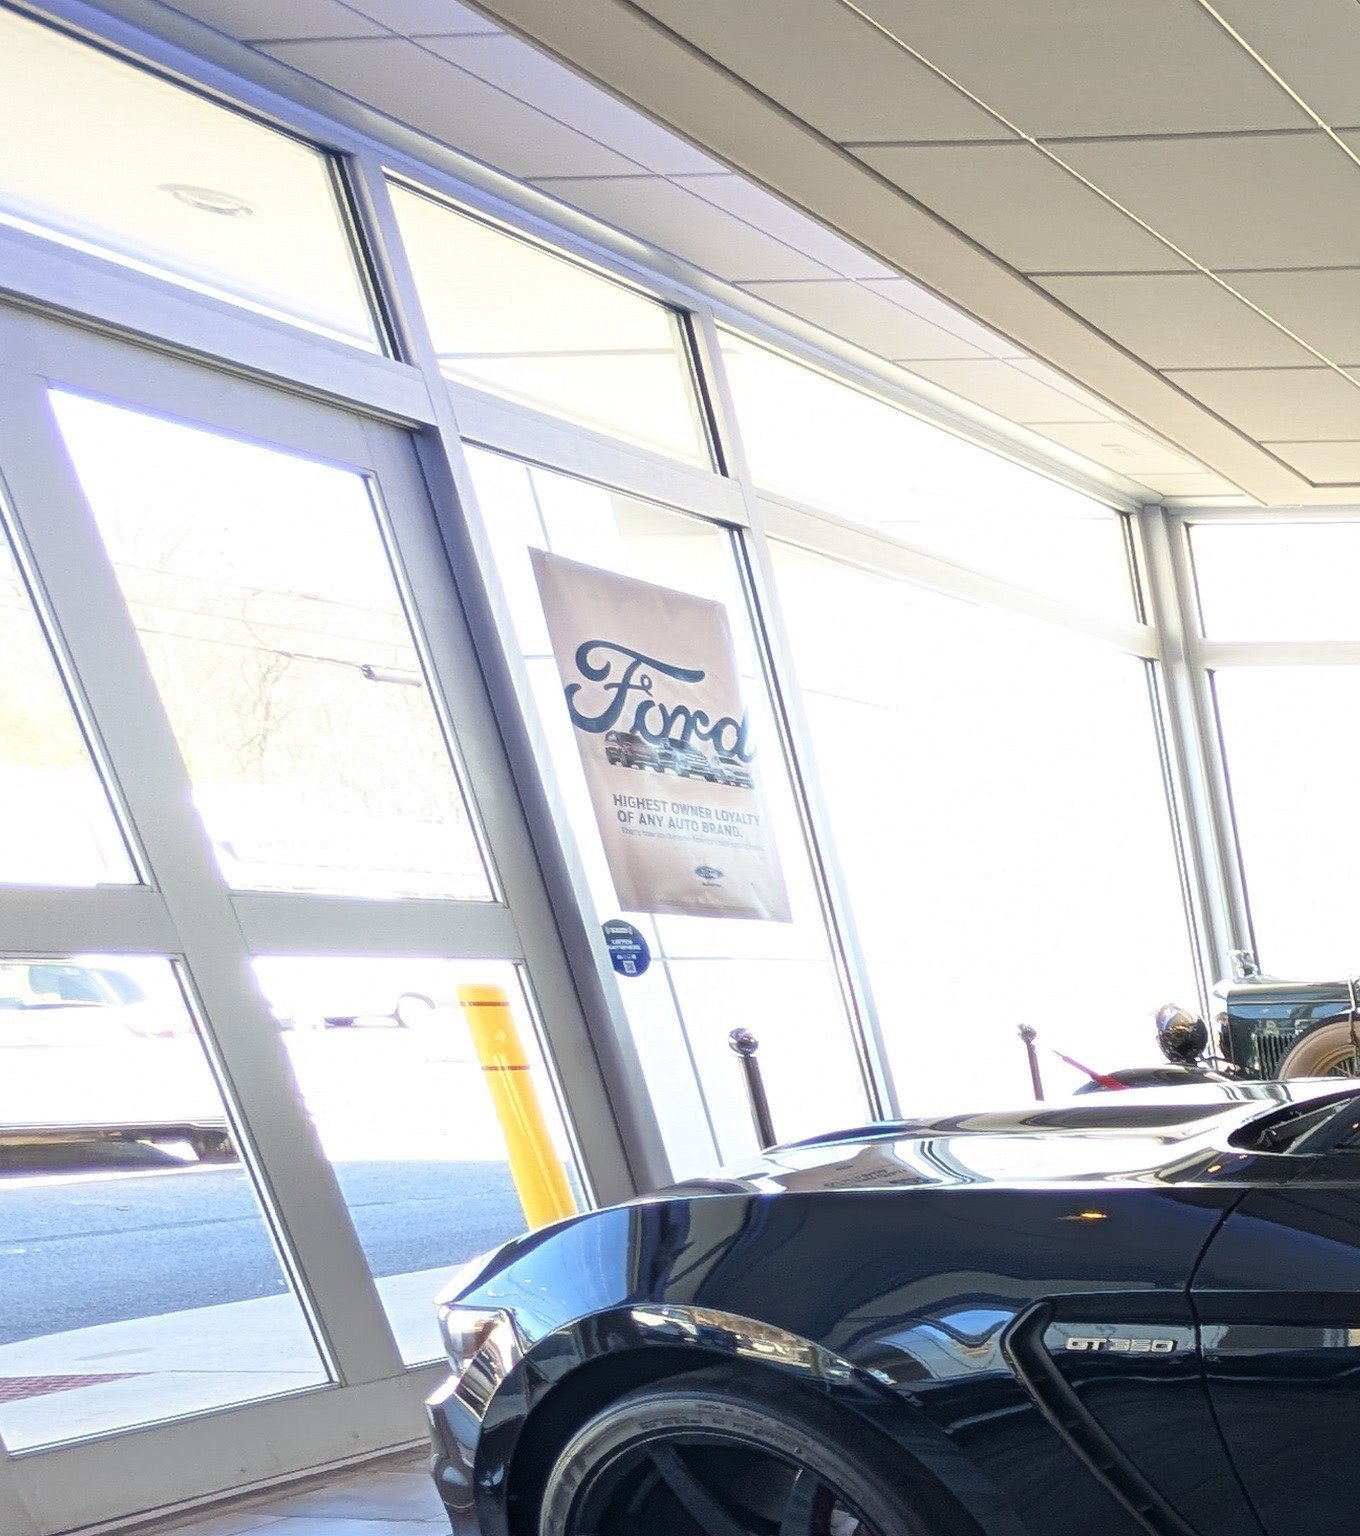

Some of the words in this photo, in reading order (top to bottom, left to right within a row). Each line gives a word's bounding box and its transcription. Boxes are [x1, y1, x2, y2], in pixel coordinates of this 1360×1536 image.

[564, 640, 757, 763] Ford
[612, 794, 668, 812] HIGHEST
[671, 802, 713, 820] OWNER
[715, 809, 761, 827] LOYALTY
[617, 810, 635, 824] OF
[638, 812, 665, 828] ANY
[668, 817, 699, 832] AUTO
[702, 822, 744, 838] BRAND.
[1065, 1337, 1175, 1353] GT350
